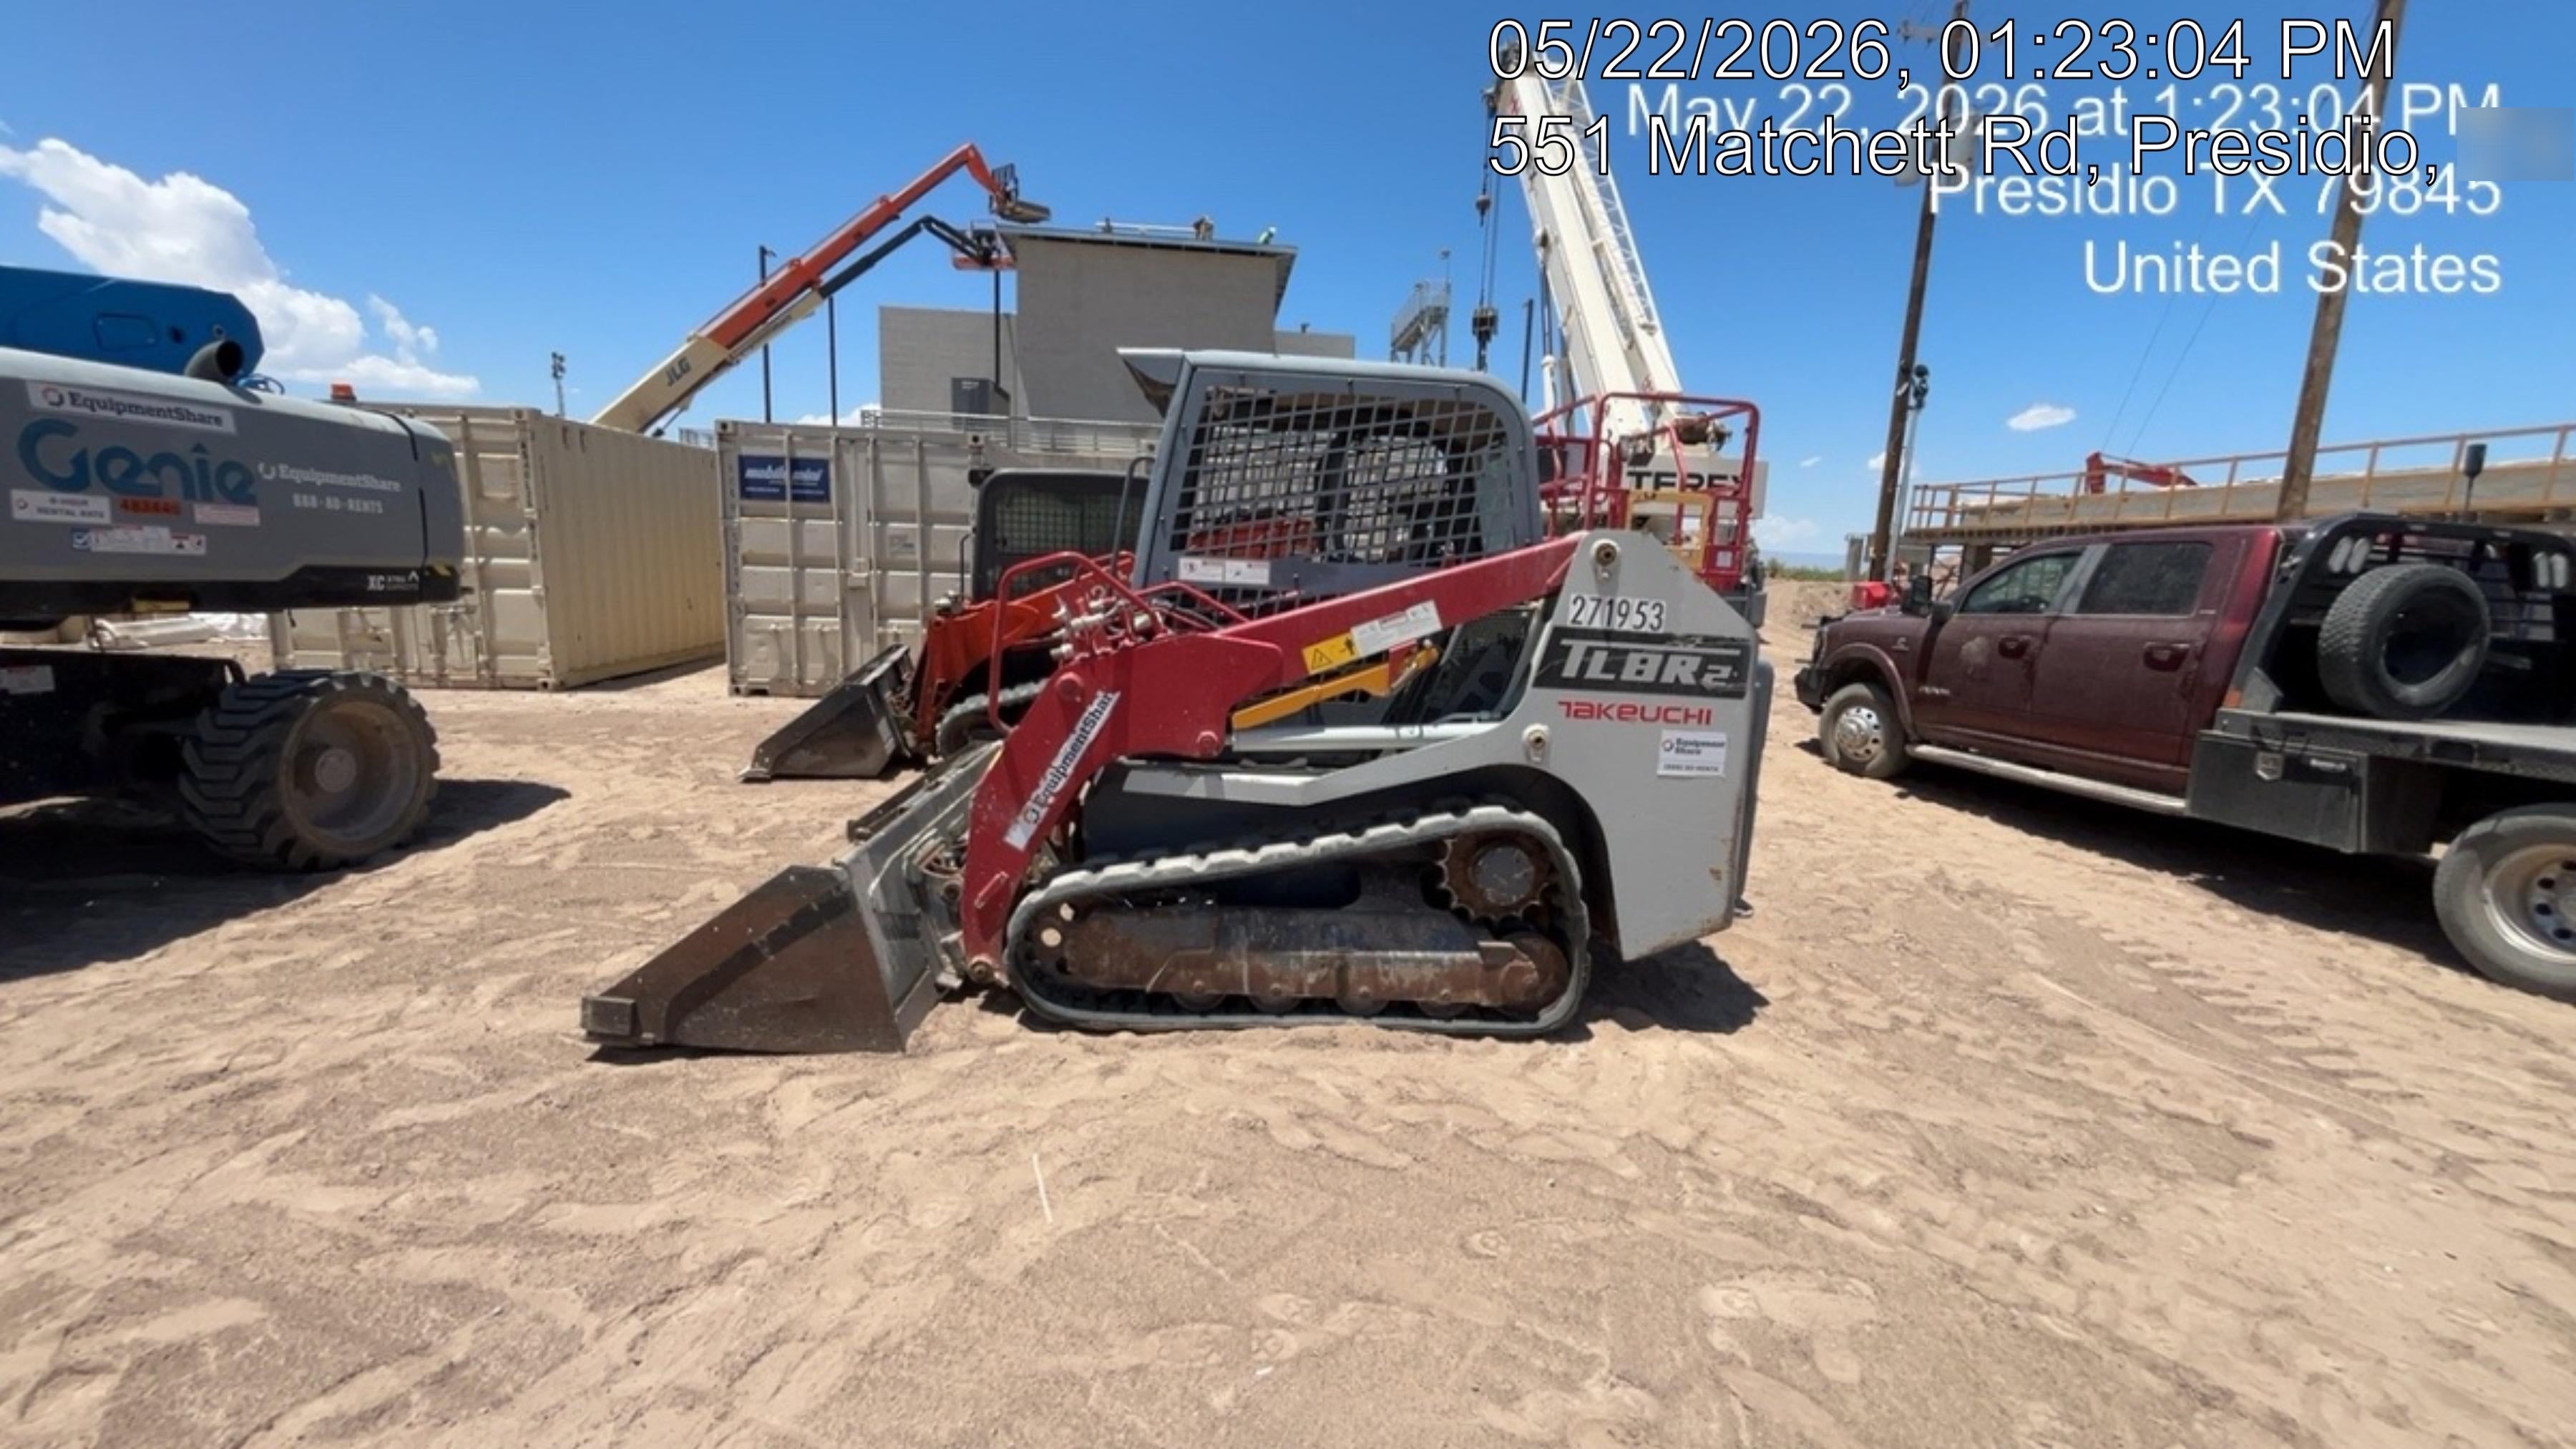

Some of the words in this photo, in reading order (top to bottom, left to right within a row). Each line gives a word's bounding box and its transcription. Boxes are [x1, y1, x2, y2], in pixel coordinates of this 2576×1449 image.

[665, 356, 692, 387] JLG
[68, 391, 223, 427] EquipmentShare
[18, 418, 257, 504] Genie
[278, 464, 402, 492] EquipmentShare
[1571, 595, 1665, 632] 271953
